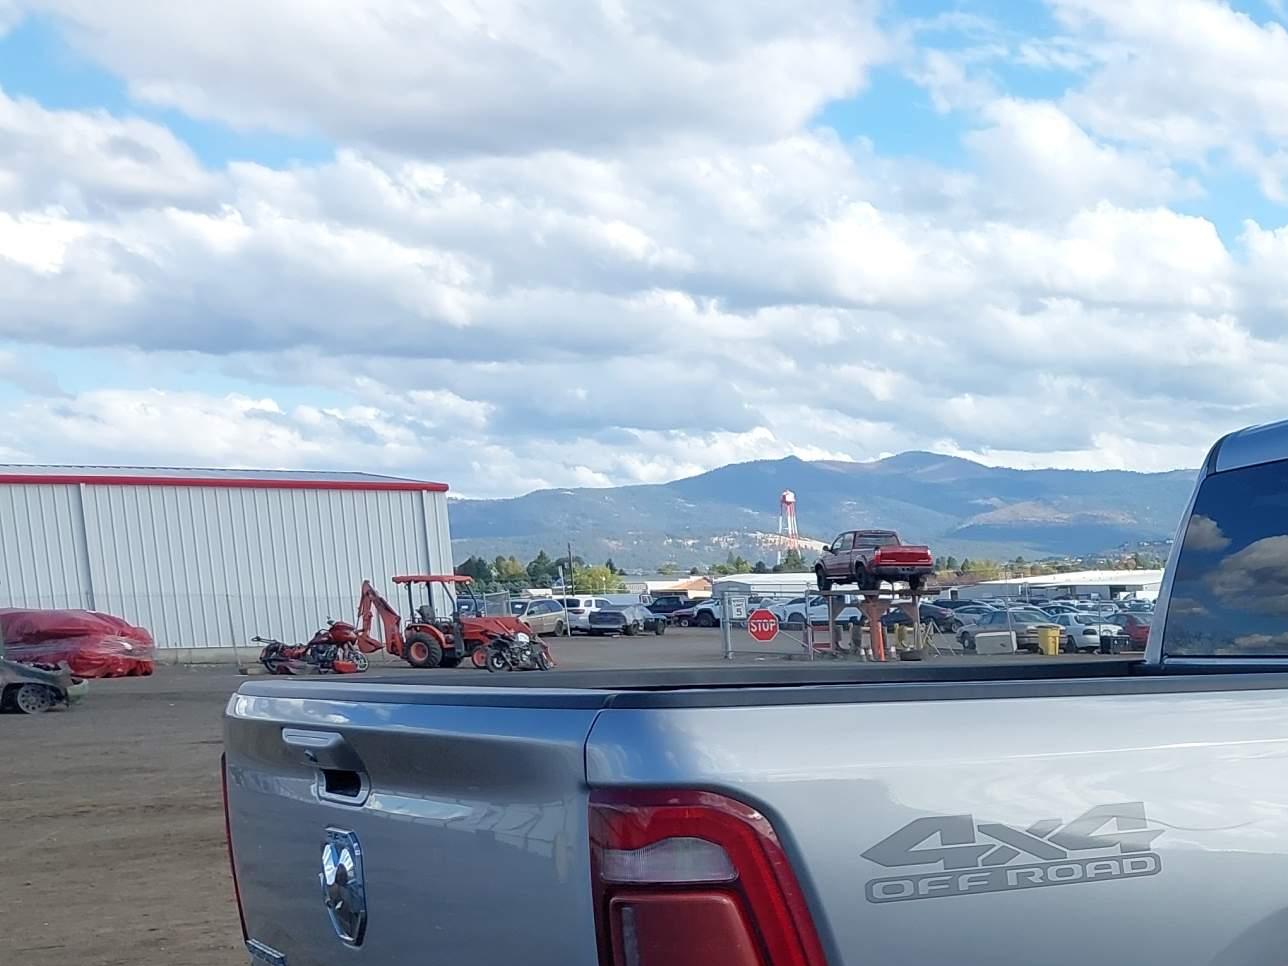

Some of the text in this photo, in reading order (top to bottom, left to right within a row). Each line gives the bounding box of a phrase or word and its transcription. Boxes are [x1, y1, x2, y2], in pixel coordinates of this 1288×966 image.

[750, 619, 776, 632] STOP
[870, 856, 1157, 900] OFF ROAD
